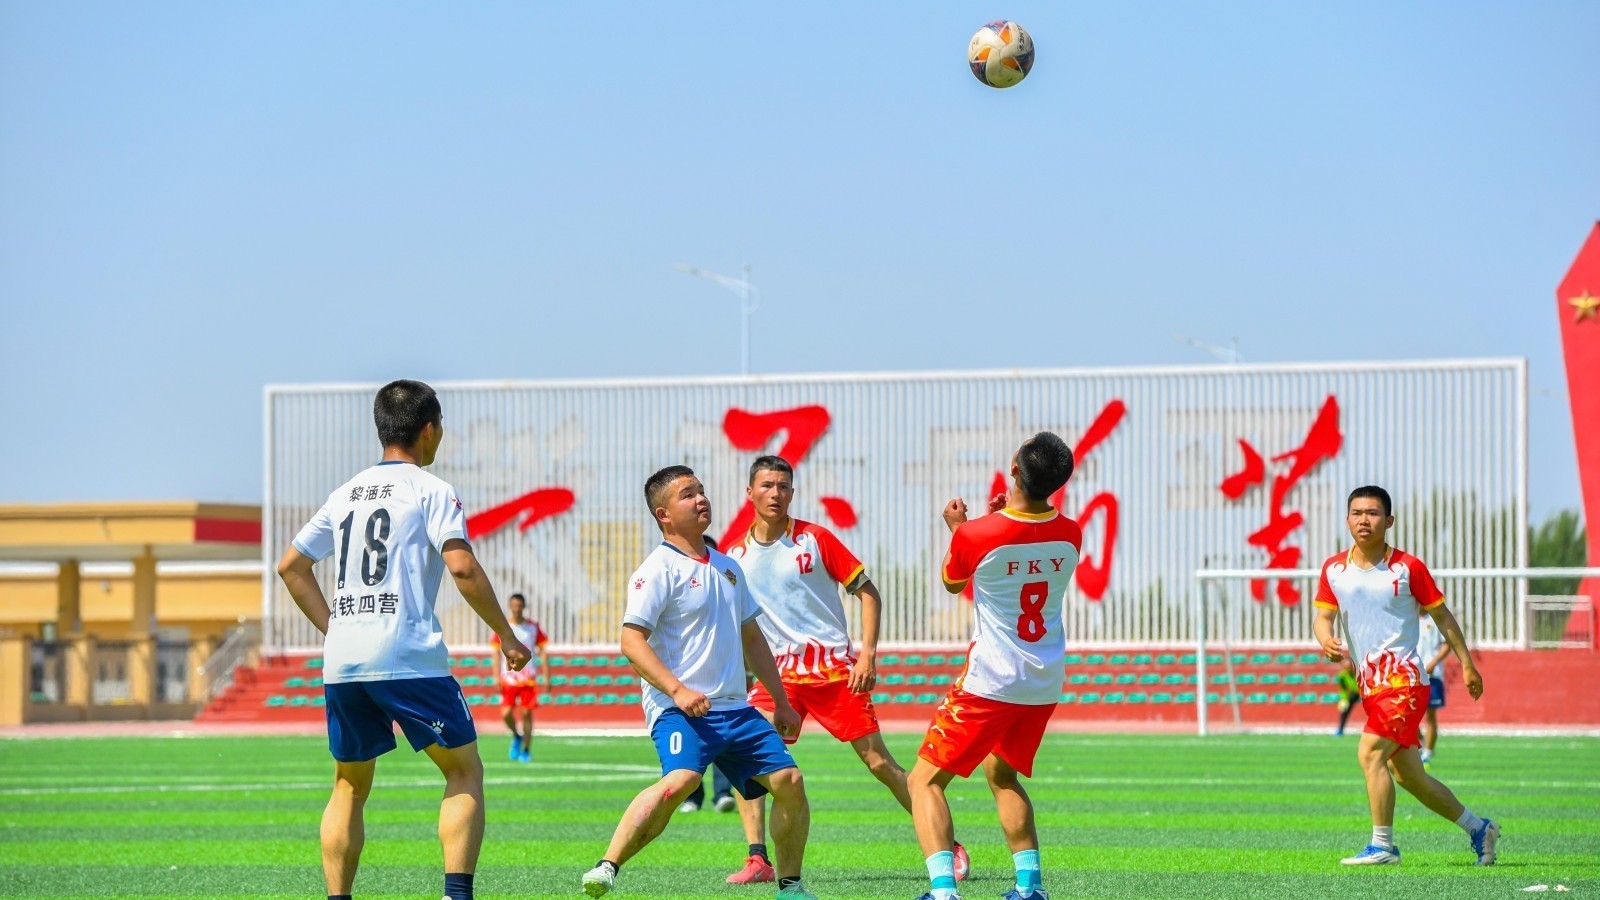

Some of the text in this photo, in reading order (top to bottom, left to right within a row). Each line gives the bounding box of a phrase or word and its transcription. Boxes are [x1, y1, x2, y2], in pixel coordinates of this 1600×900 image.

[349, 483, 395, 502] 黎涵东
[338, 507, 391, 590] 18
[796, 553, 812, 574] 12
[1007, 558, 1065, 575] FKY
[1017, 581, 1048, 642] 8
[670, 731, 682, 754] 0
